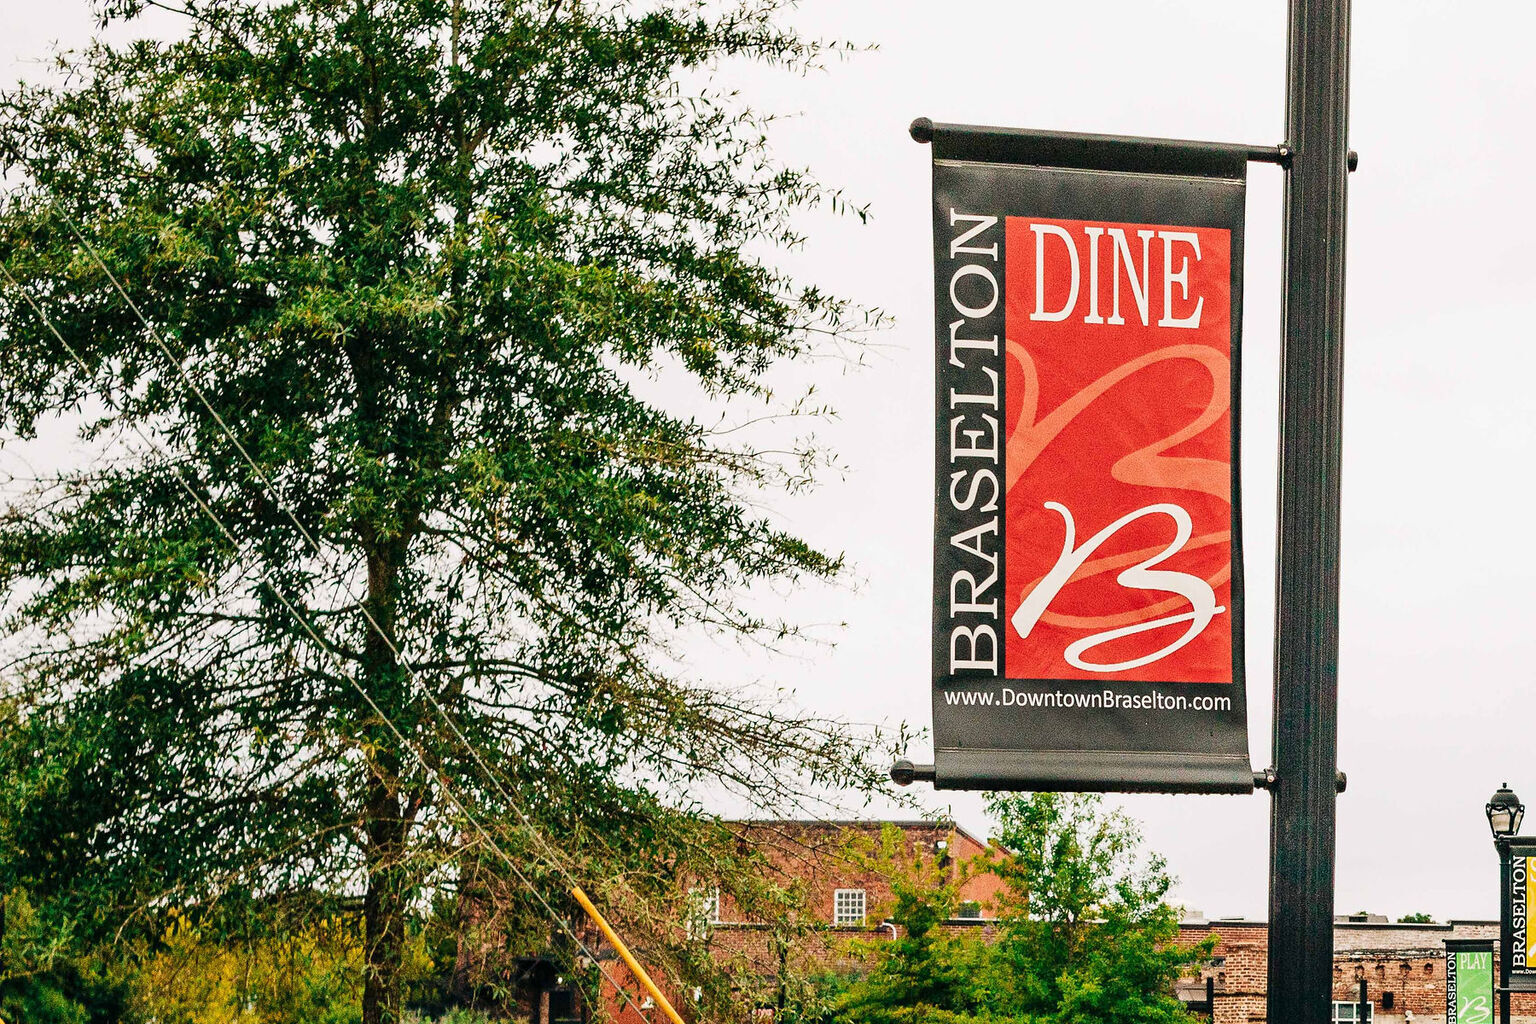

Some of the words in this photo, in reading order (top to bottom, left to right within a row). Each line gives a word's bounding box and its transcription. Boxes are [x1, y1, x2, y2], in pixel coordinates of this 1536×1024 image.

[1029, 222, 1205, 330] DINE
[949, 207, 1000, 677] BRASELTON
[1011, 500, 1226, 673] B
[944, 688, 1231, 712] www.DowntownBraselton.com
[1460, 952, 1488, 970] PLAY
[1512, 855, 1526, 967] BRASELTON
